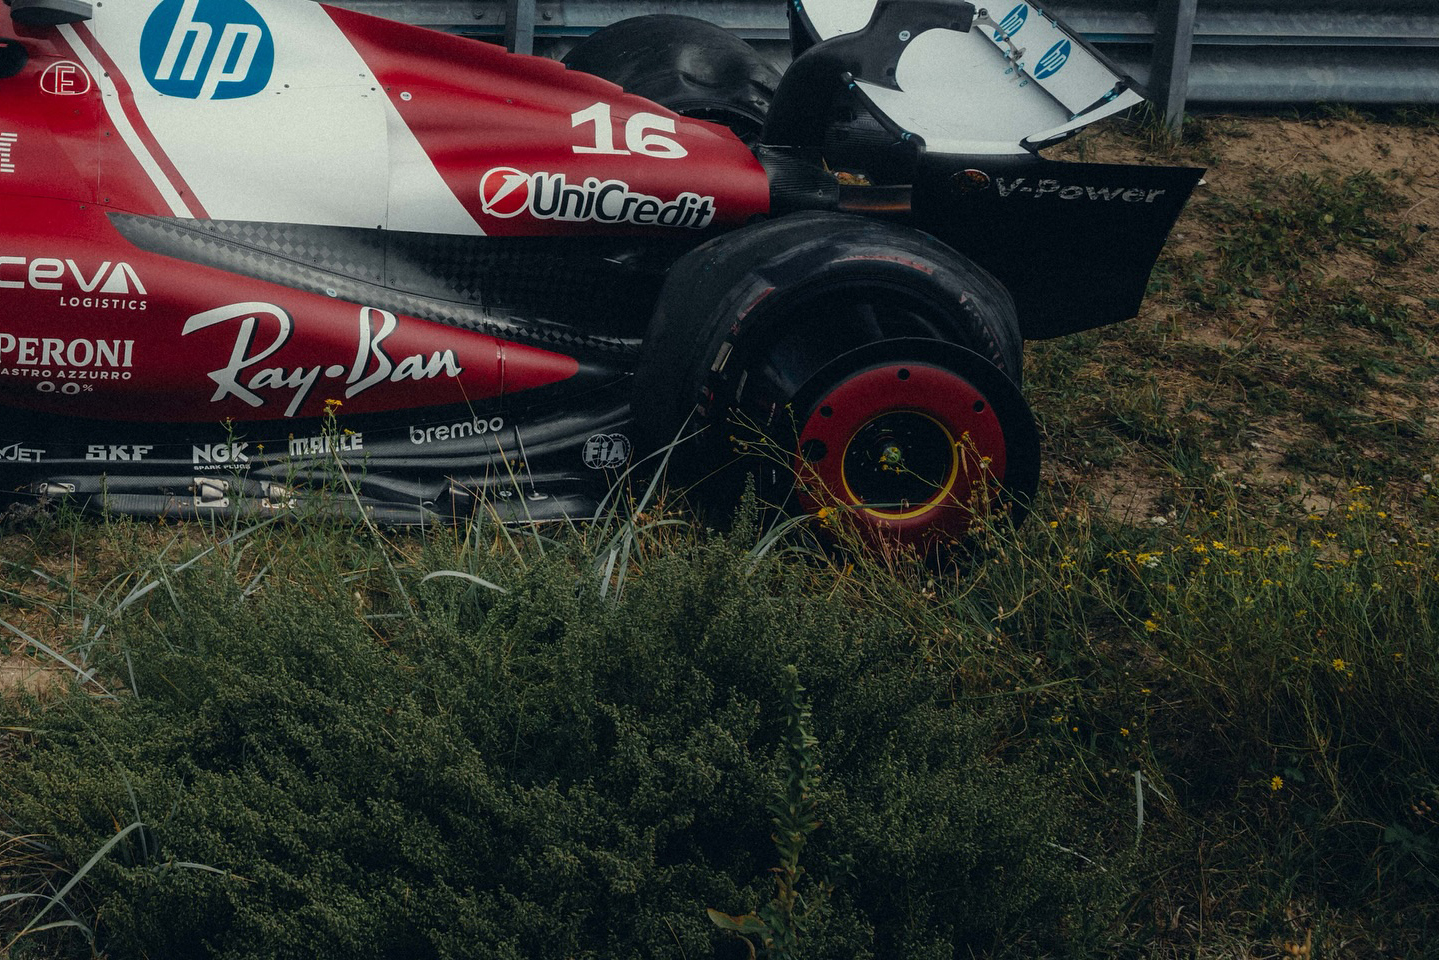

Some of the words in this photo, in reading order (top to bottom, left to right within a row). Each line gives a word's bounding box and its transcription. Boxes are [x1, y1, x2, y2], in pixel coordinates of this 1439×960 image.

[994, 4, 1026, 42] hp
[1034, 40, 1068, 77] hp
[571, 102, 688, 159] 16
[532, 175, 712, 228] UniCredit
[995, 177, 1166, 203] V-Power
[60, 297, 147, 311] LOGISTICS
[36, 380, 94, 395] 0.0%
[56, 370, 132, 380] AZZURRO
[410, 416, 504, 445] brembo
[86, 444, 154, 461] SKF
[192, 442, 249, 464] NGK
